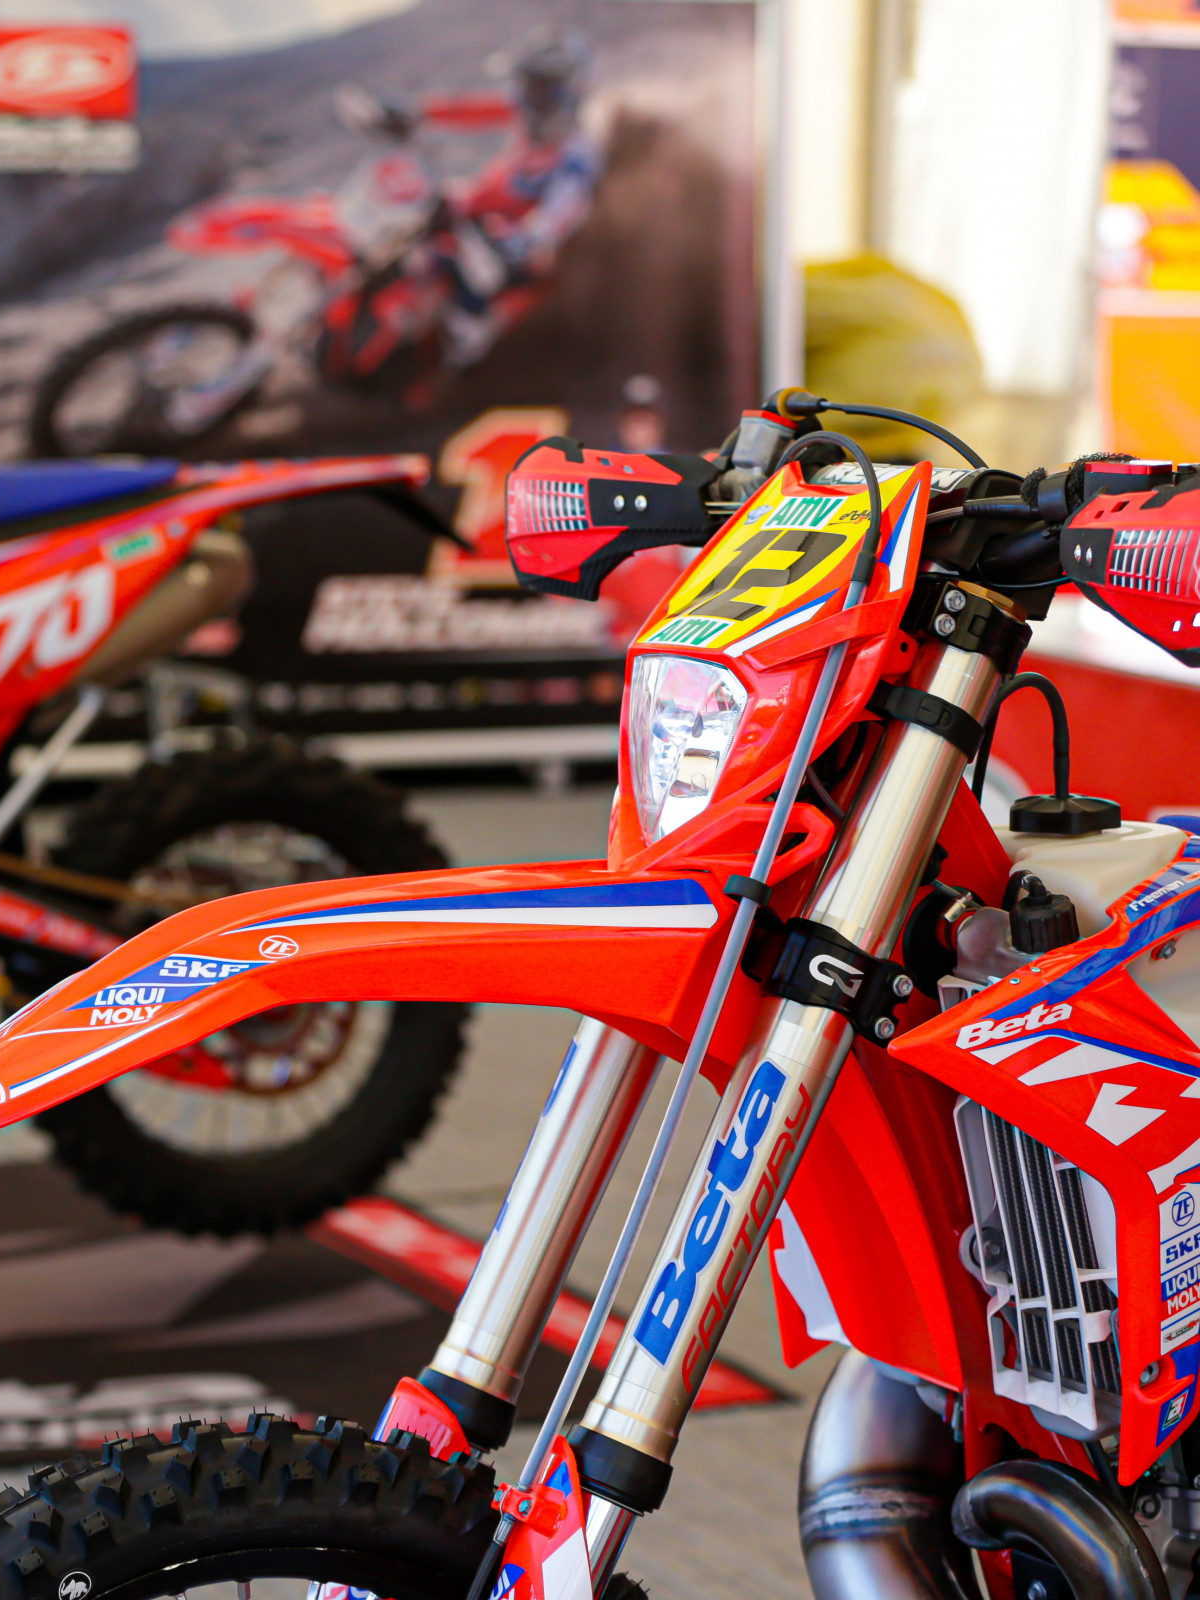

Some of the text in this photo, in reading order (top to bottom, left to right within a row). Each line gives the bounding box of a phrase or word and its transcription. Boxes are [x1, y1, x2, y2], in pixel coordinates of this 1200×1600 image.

[664, 529, 848, 622] 12
[1128, 879, 1185, 912] Freeman
[262, 937, 298, 957] ZF
[158, 958, 251, 979] SKF
[93, 986, 167, 1006] LIQUI
[89, 1004, 164, 1027] MOLY
[955, 1002, 1074, 1050] Beta
[631, 1058, 789, 1370] Beta
[1172, 1195, 1195, 1223] ZF
[681, 1081, 813, 1395] FACTORY
